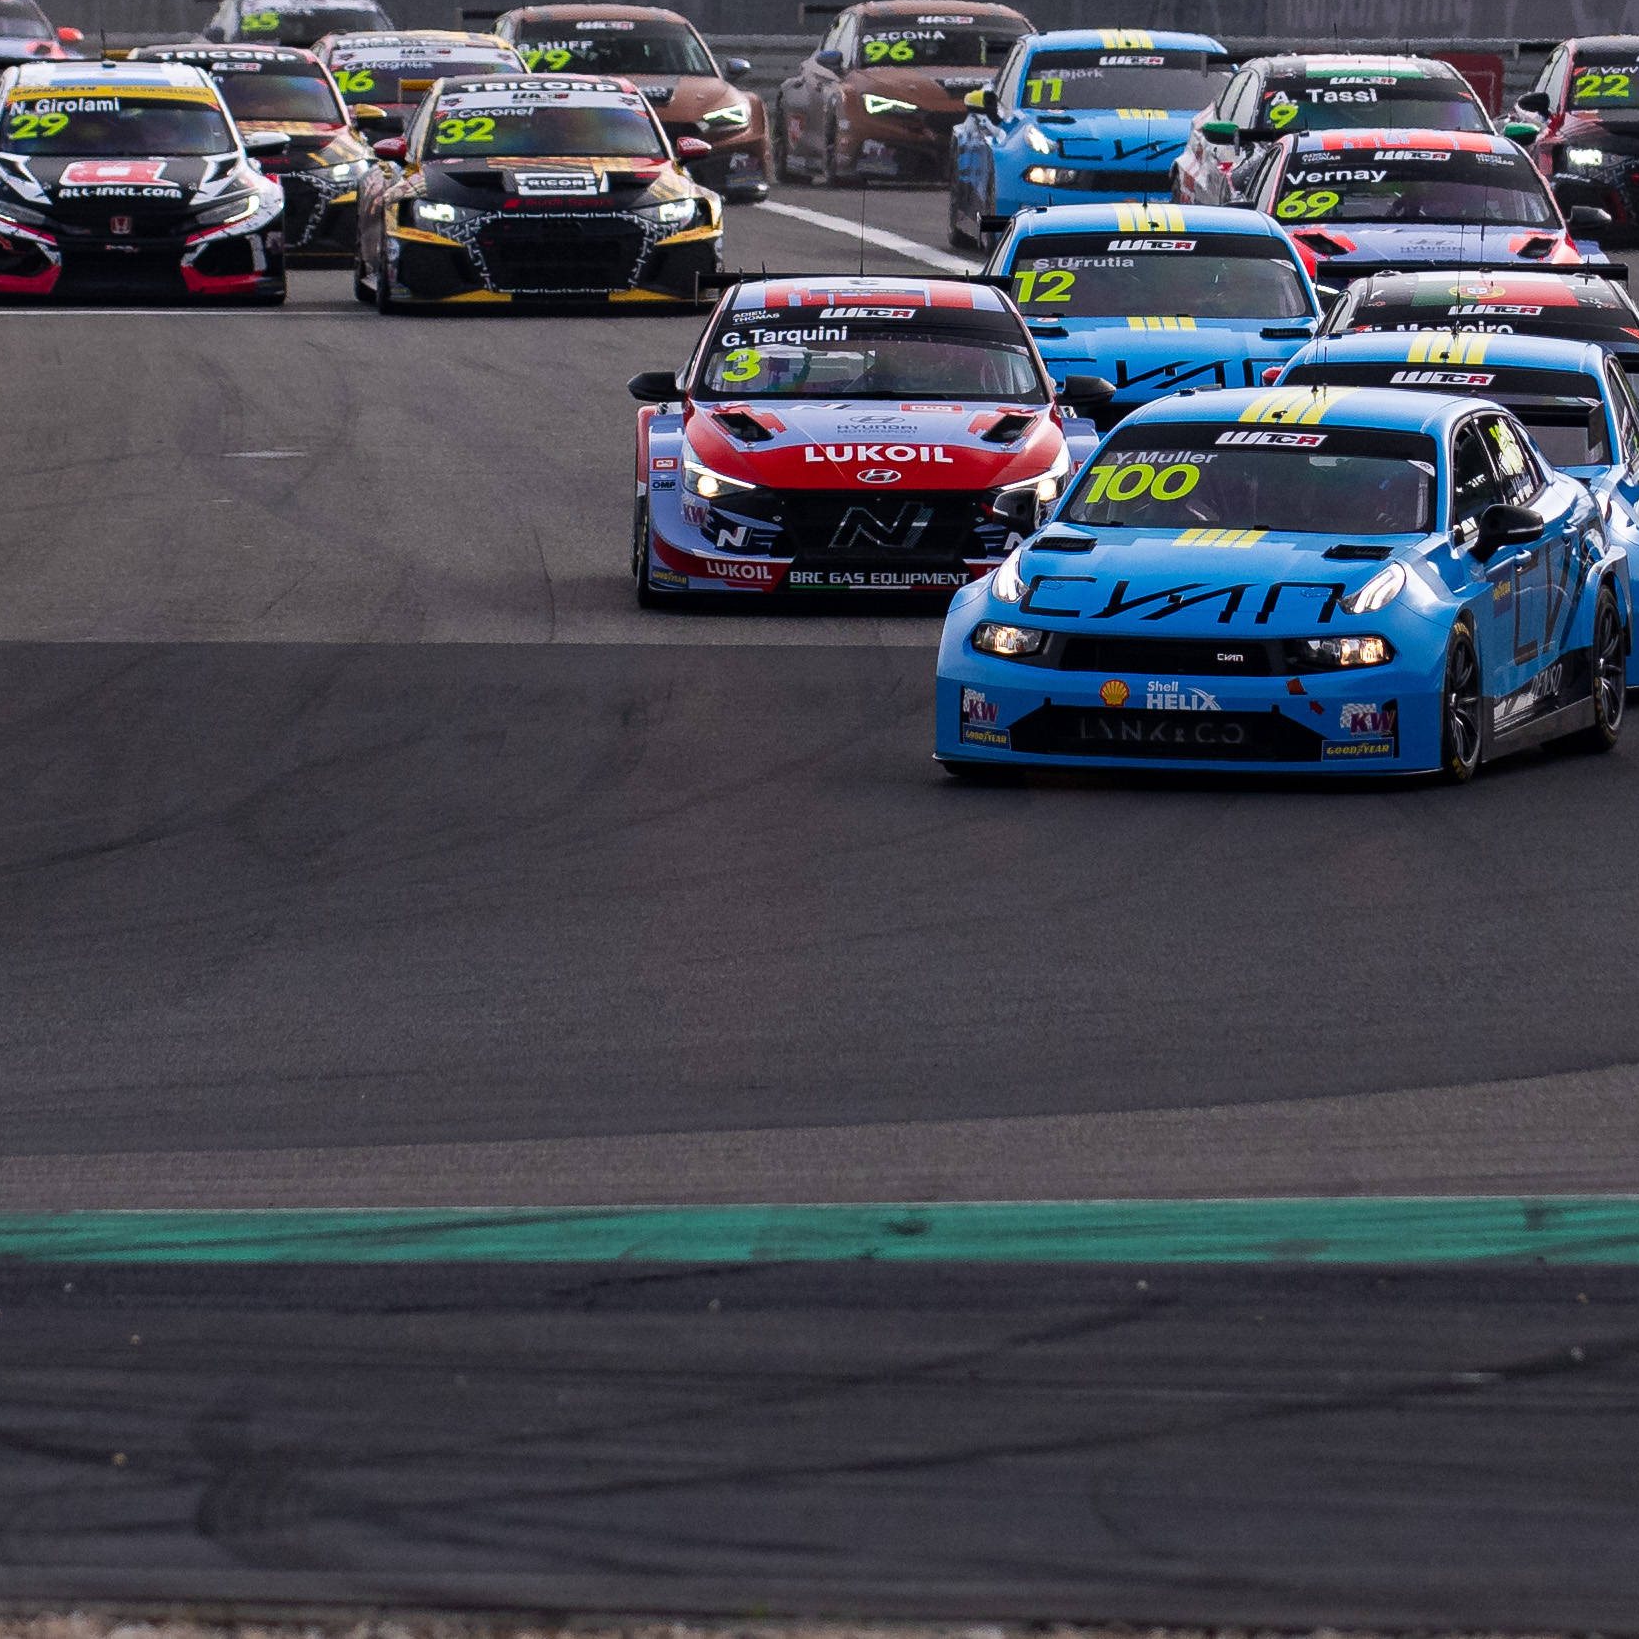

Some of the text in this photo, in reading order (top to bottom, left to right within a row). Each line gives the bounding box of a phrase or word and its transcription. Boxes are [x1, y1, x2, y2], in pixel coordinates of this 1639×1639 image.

[522, 49, 572, 71] 79
[866, 40, 915, 62] 96
[334, 70, 374, 93] 16
[462, 81, 618, 92] TRICORP
[1574, 74, 1630, 98] 22
[1027, 79, 1063, 104] 11
[1306, 88, 1378, 103] Tassi
[35, 97, 120, 112] Girolami
[1270, 105, 1298, 129] 9
[10, 113, 69, 140] 29
[436, 118, 495, 145] 32
[1286, 170, 1387, 185] Vernay
[1277, 191, 1340, 218] 69
[1107, 240, 1197, 251] WTCR
[1014, 271, 1075, 303] 12
[733, 313, 780, 323] THOMAS
[819, 307, 916, 318] WTCR
[1448, 305, 1543, 315] WTCR
[722, 347, 761, 381] 3
[1390, 371, 1496, 385] WTCR
[1215, 432, 1326, 447] WTCR
[805, 446, 954, 463] LUKOIL
[652, 480, 676, 490] OMP
[1084, 463, 1200, 504] 100
[682, 505, 708, 524] KW
[707, 561, 773, 579] LUKOIL
[790, 571, 969, 585] BRC GAS EQUIPMENT
[1147, 681, 1179, 692] Shell
[1146, 690, 1222, 711] HELIX
[969, 699, 999, 723] KW
[1350, 711, 1397, 734] KW
[965, 729, 1007, 744] GOODYEAR
[1326, 742, 1390, 756] GOODYEAR
